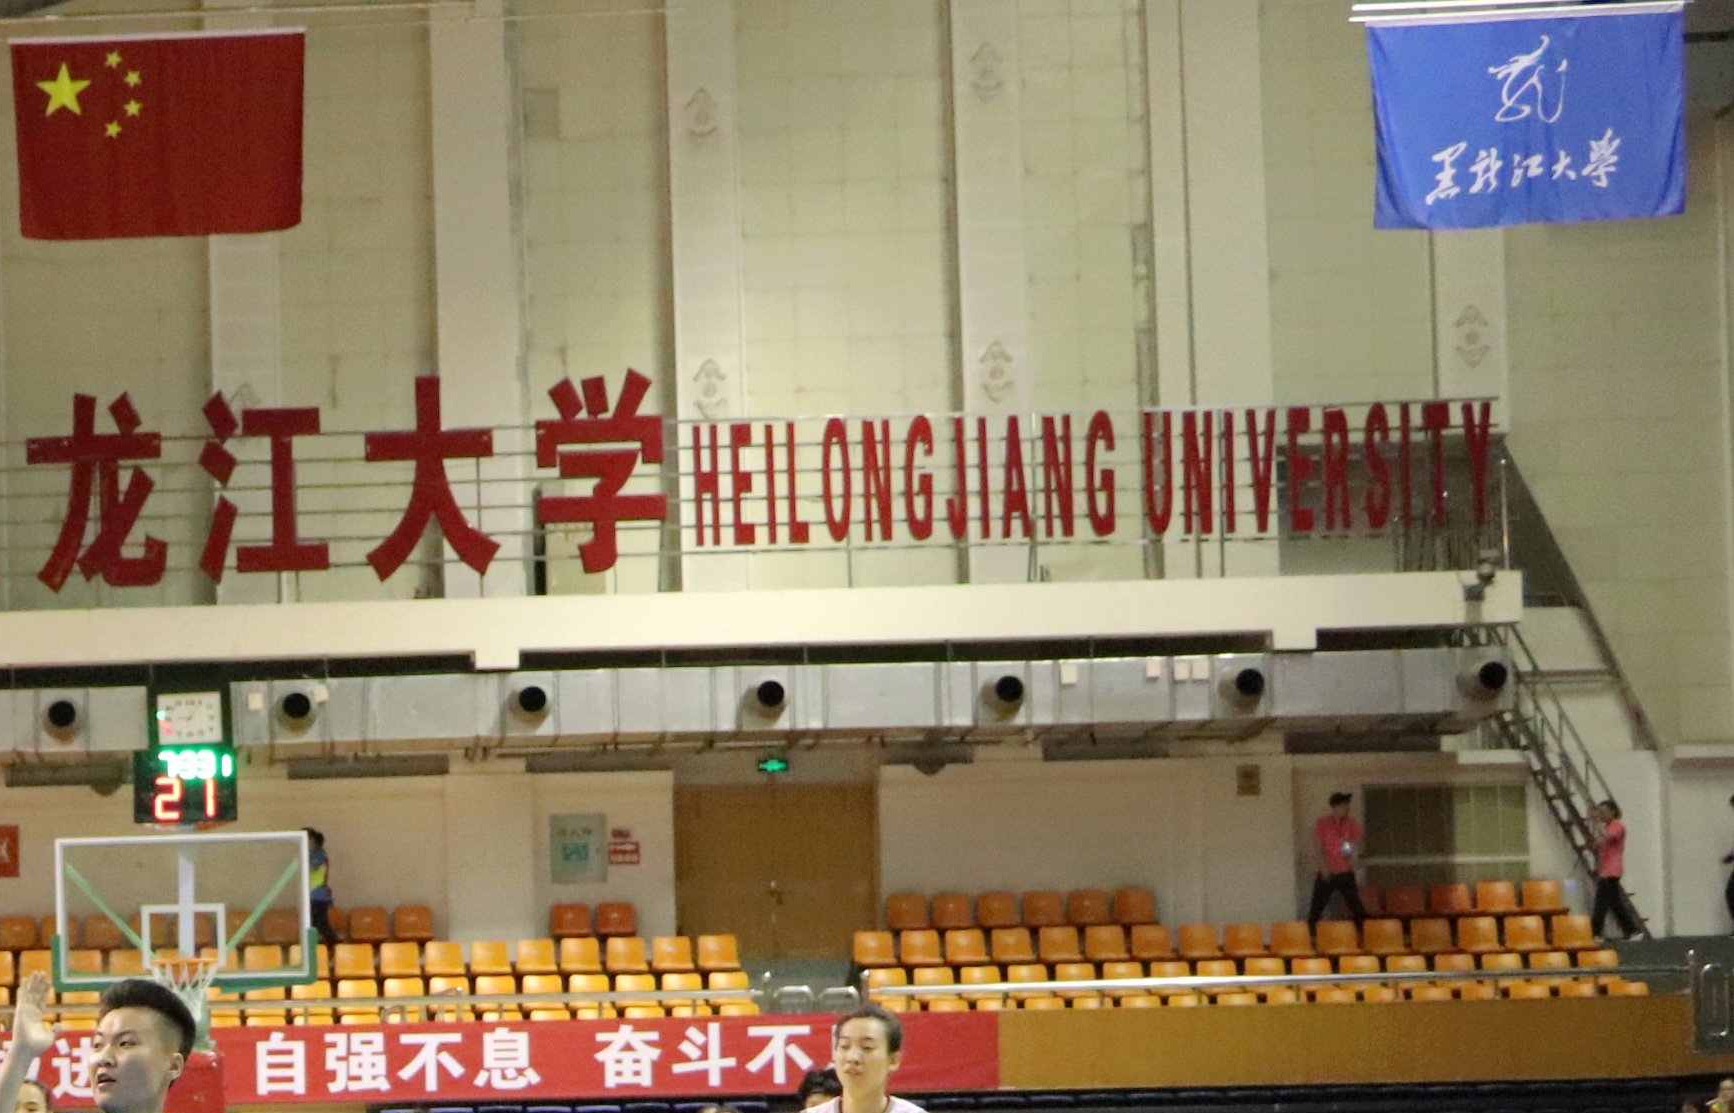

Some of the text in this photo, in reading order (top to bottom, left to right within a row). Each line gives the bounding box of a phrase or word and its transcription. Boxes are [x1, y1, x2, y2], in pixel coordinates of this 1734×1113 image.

[692, 400, 1493, 547] HEILONGJIANG UNIVERSITY
[255, 1025, 541, 1096] 自强不息
[594, 1023, 837, 1088] 奋斗不
